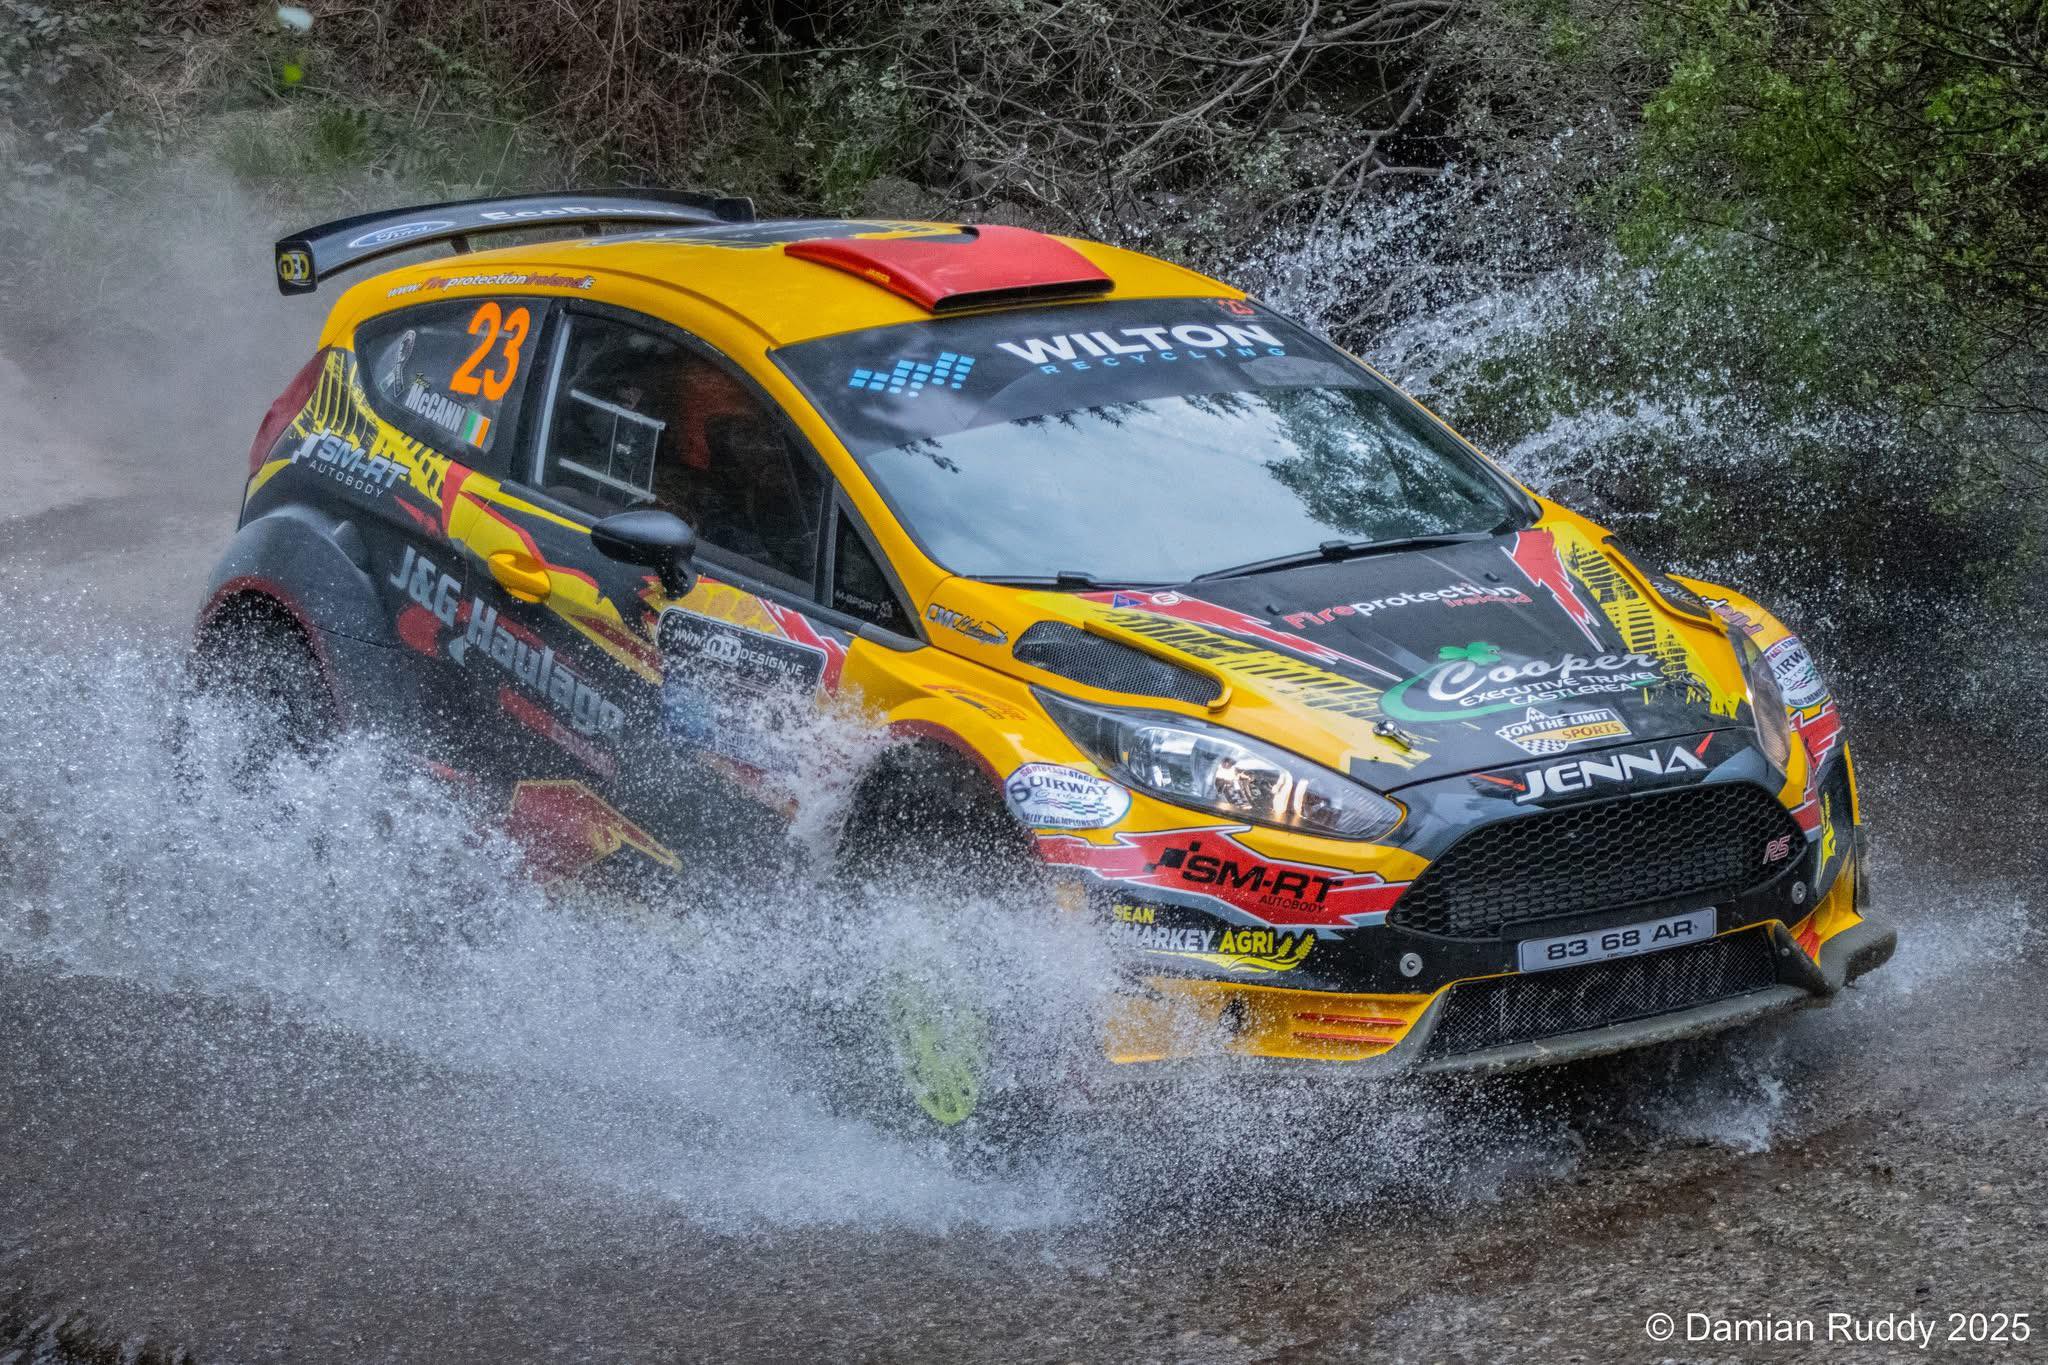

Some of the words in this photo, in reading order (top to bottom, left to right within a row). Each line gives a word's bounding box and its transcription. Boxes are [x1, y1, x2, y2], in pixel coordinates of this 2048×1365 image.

[449, 302, 531, 401] 23
[996, 324, 1285, 364] WILTON
[1040, 347, 1286, 375] RECYCLING
[404, 383, 467, 432] McCANN
[309, 460, 384, 498] AUTOBODY
[391, 545, 462, 628] J&G
[464, 597, 626, 740] Haulage
[1428, 653, 1659, 700] Cooper
[1460, 677, 1577, 707] EXECUTIVE
[1580, 671, 1663, 684] TRAVEL
[1509, 683, 1637, 706] CASTLEREA
[1512, 722, 1531, 736] ON
[1535, 716, 1568, 731] THE
[1571, 711, 1609, 727] LIMIT
[1561, 721, 1622, 741] SPORTS
[1009, 776, 1111, 802] SUIRWAY
[1516, 746, 1708, 803] JENNA
[1113, 904, 1156, 924] SEAN
[1259, 895, 1326, 914] AUTOBODY
[1108, 921, 1216, 951] SHARKEY
[1218, 930, 1274, 954] AGRI
[1547, 938, 1588, 960] 83
[1601, 929, 1640, 951] 68
[1652, 919, 1693, 942] AR
